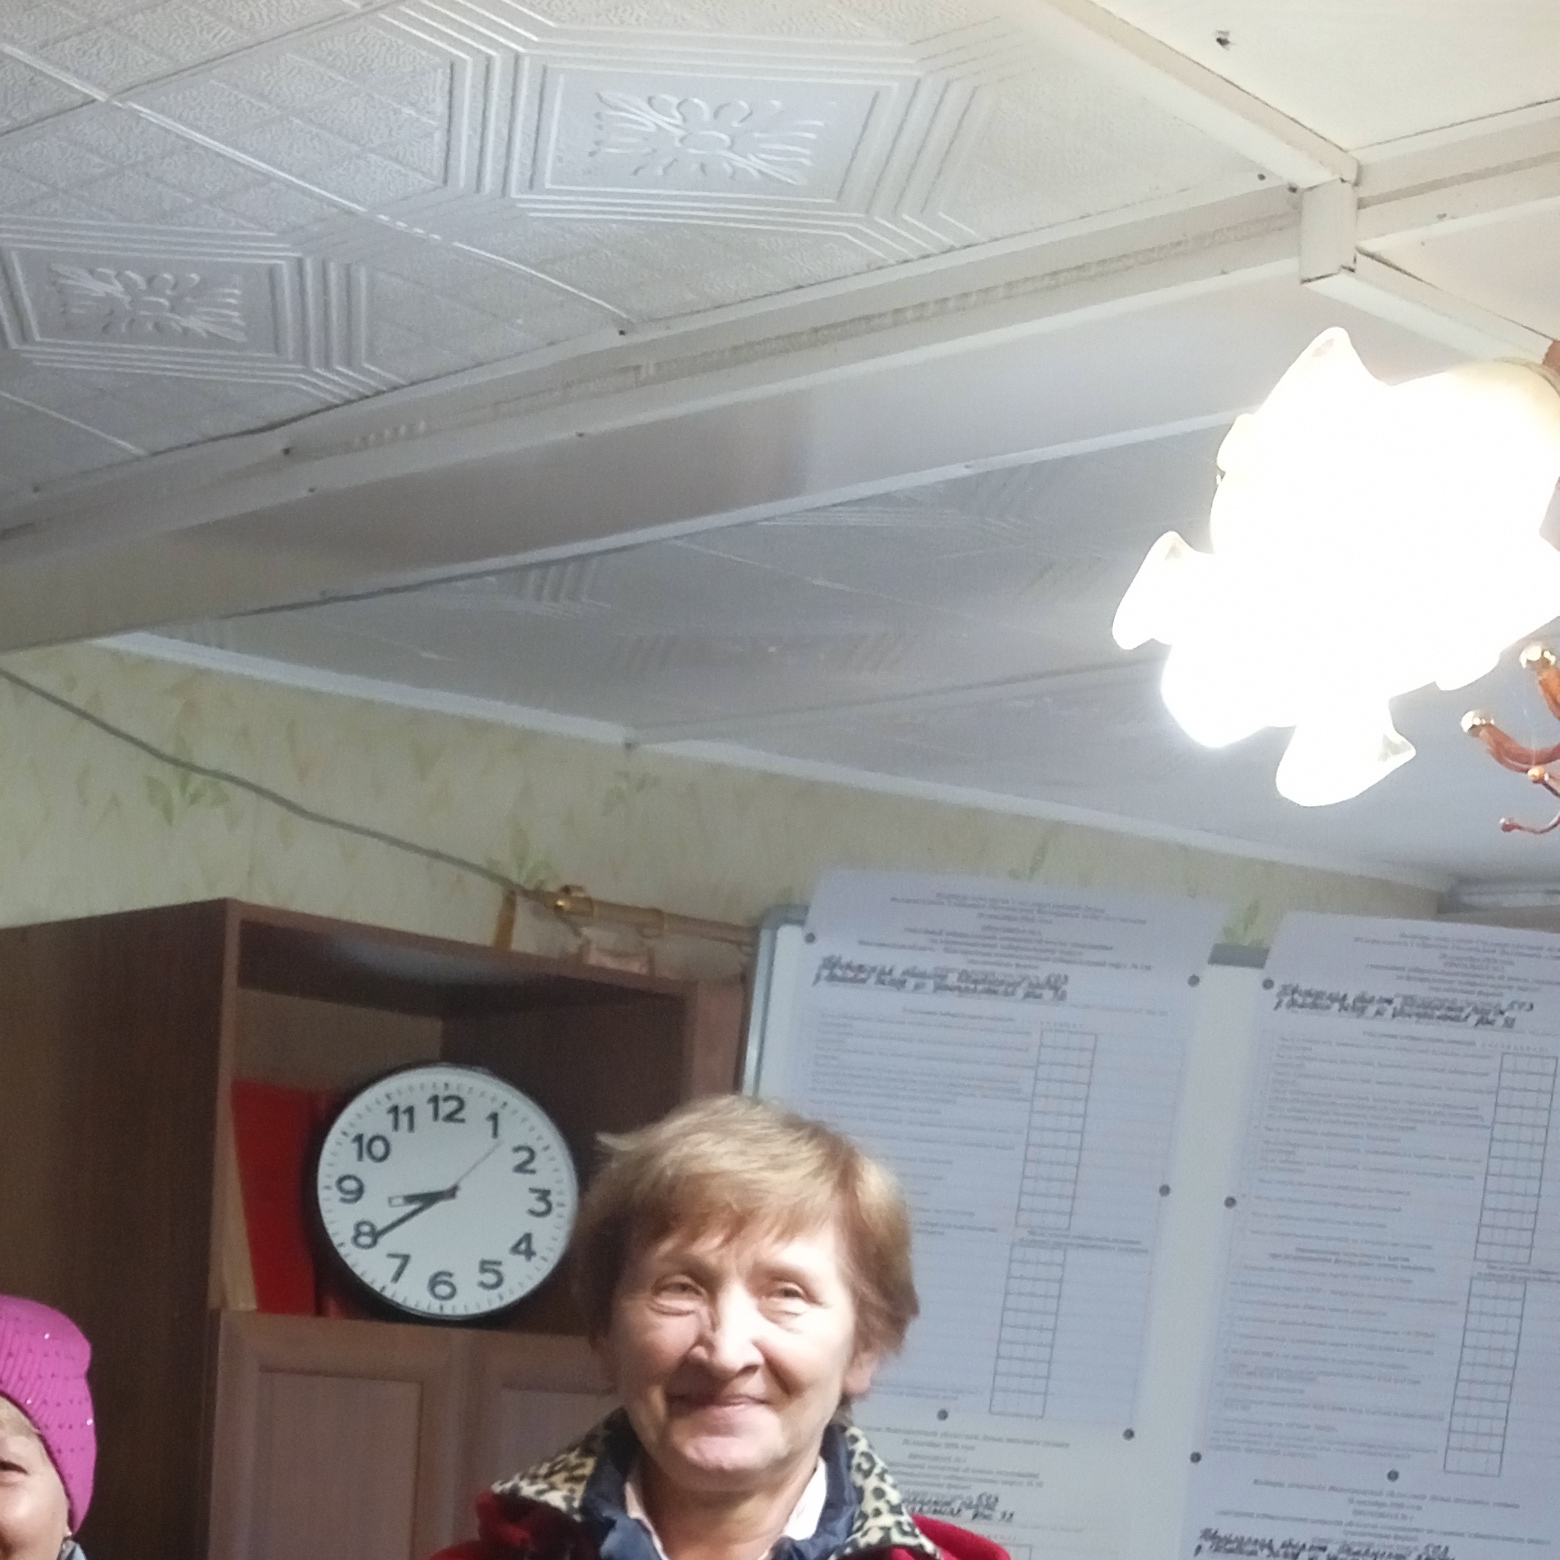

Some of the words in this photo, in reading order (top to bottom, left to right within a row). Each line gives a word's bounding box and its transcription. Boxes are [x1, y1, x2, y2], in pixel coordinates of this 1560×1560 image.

[386, 1104, 417, 1134] 11
[426, 1093, 466, 1124] 12
[485, 1111, 500, 1139] 1
[351, 1132, 391, 1163] 10
[511, 1145, 537, 1175] 2
[335, 1174, 364, 1204] 9
[527, 1187, 554, 1218] 3
[350, 1219, 378, 1249] 8
[509, 1232, 537, 1262] 4
[386, 1252, 411, 1284] 7
[477, 1259, 504, 1290] 5
[427, 1270, 457, 1301] 6
